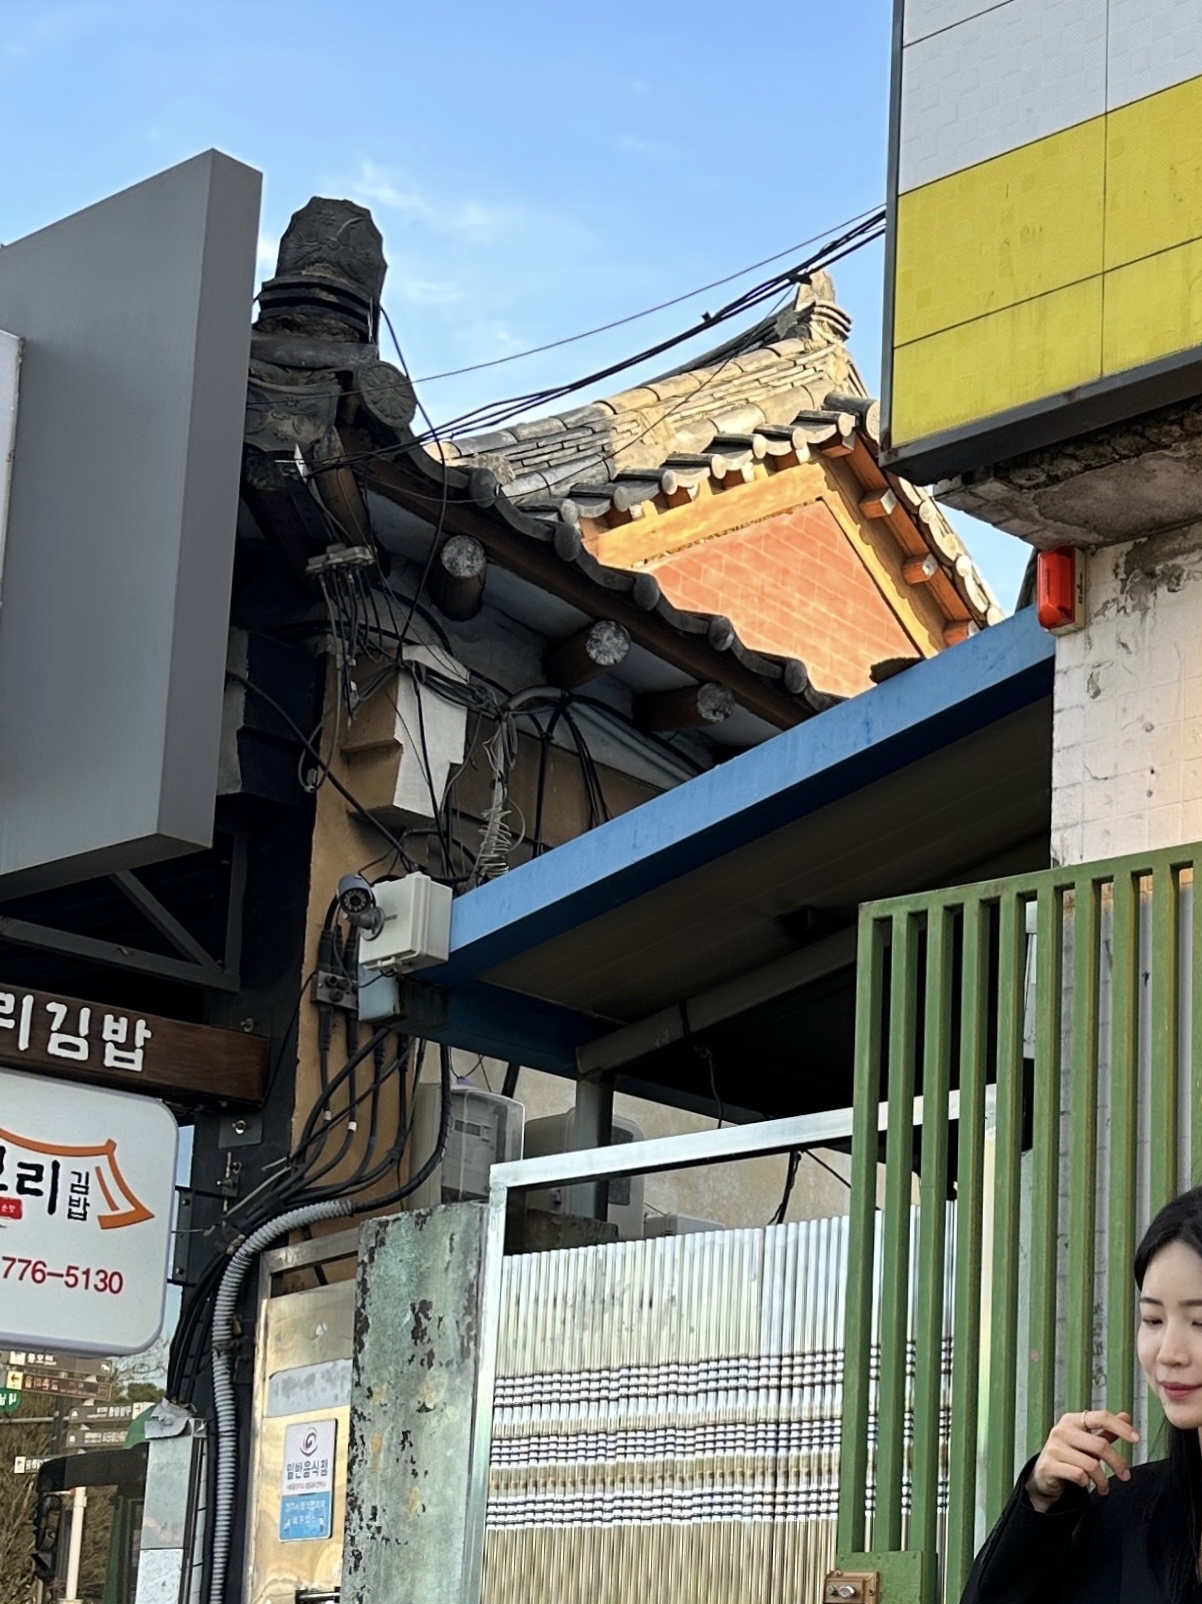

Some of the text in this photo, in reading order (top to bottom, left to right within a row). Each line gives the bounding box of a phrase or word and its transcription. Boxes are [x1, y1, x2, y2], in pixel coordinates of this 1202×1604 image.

[0, 1146, 61, 1215] 리
[67, 1171, 91, 1221] 김밥
[2, 1256, 124, 1295] 776-5130
[286, 1458, 328, 1480] 일반음식점
